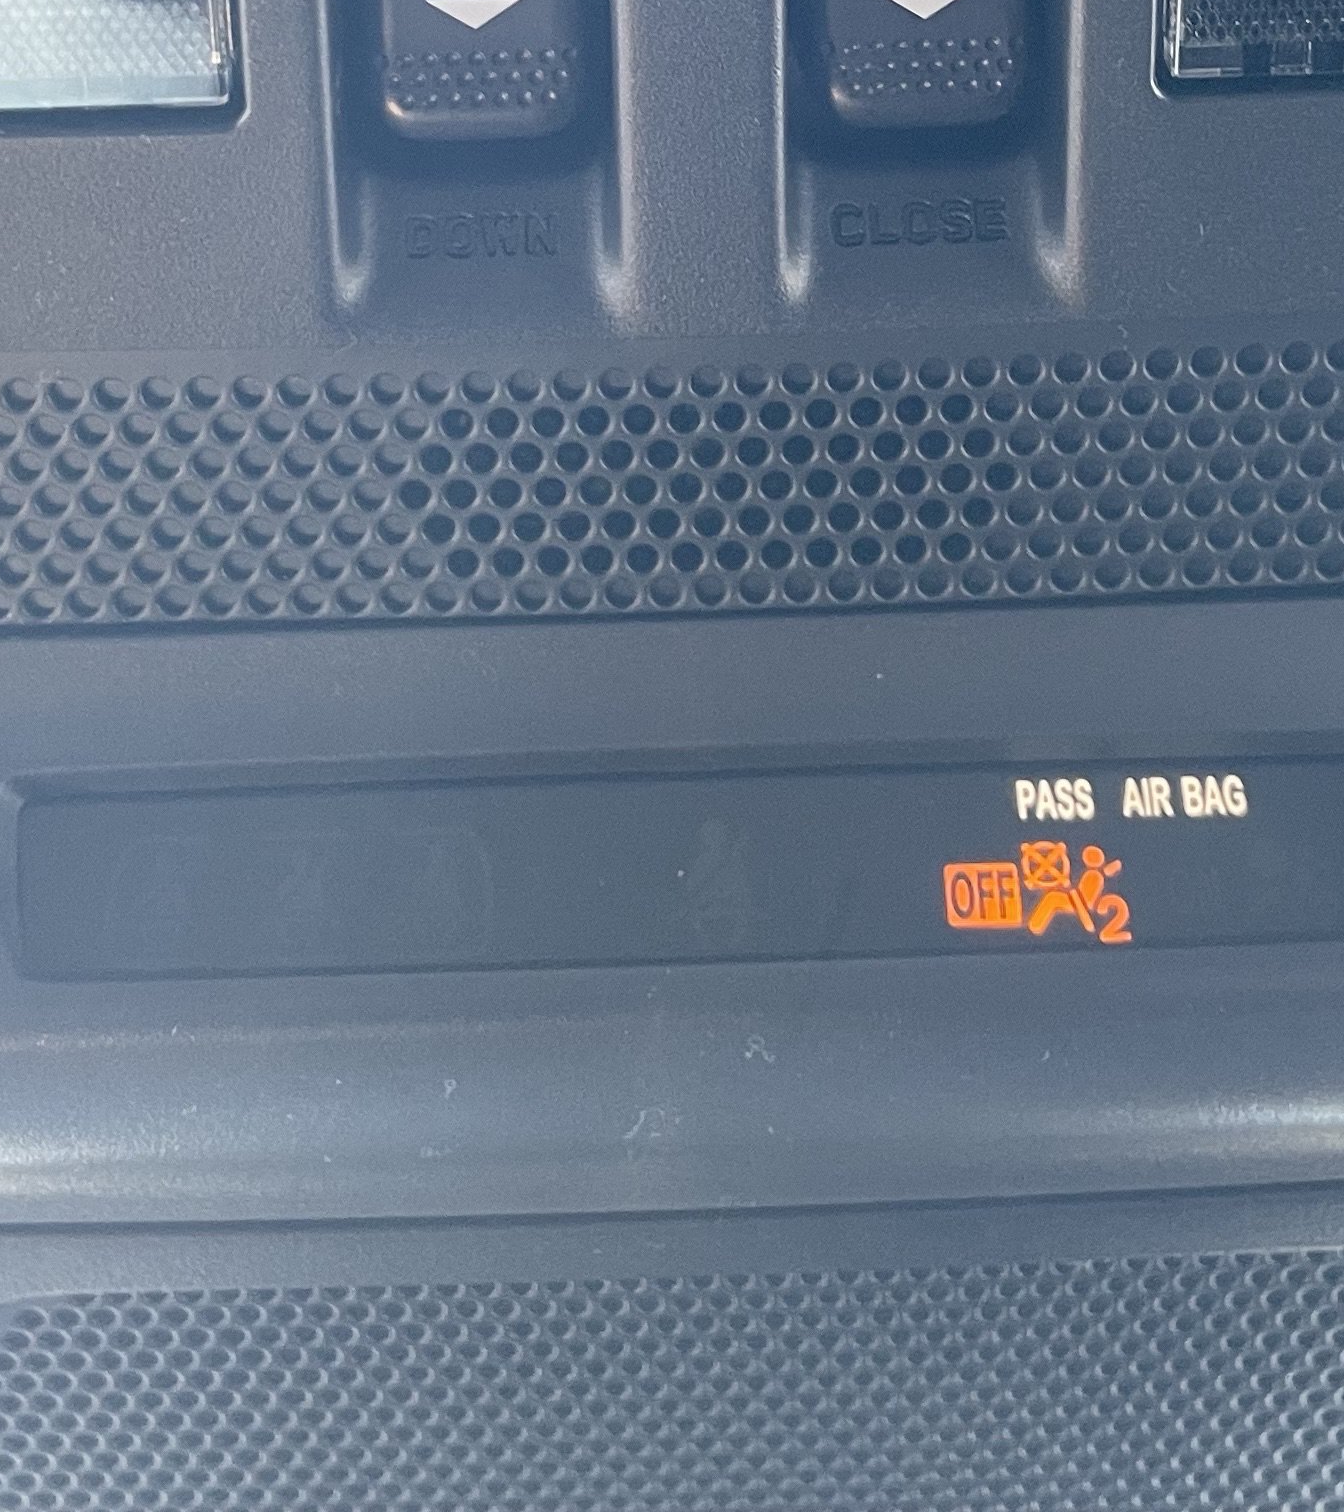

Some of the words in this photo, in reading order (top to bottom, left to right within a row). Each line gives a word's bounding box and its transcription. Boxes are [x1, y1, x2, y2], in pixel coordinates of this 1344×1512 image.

[404, 211, 558, 260] DOWN
[828, 197, 1008, 248] CLOSE
[1014, 778, 1096, 822] PASS
[1122, 775, 1176, 818] AIR
[1179, 773, 1249, 818] BAG
[950, 869, 1018, 919] OFF
[1096, 893, 1132, 944] 2
